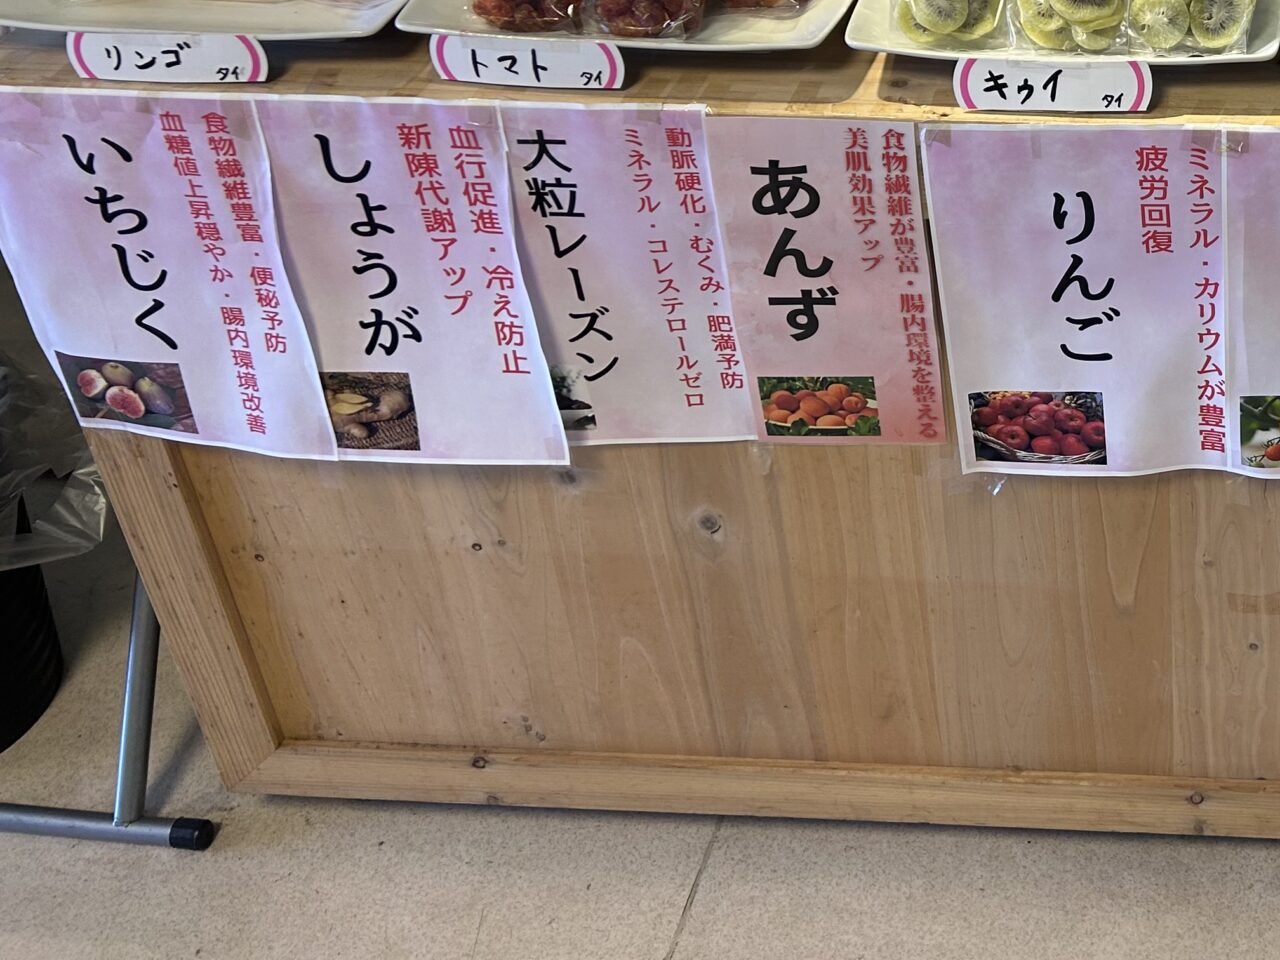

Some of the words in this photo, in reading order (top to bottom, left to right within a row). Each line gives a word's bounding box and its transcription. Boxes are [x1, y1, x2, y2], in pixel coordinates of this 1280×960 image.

[104, 42, 192, 71] リンゴ
[216, 66, 241, 81] タイ
[469, 50, 548, 83] トマト
[580, 71, 603, 86] タイ
[1102, 93, 1123, 108] タイ
[62, 134, 178, 350] いちじく
[159, 112, 267, 435] 血糖値上昇穏やか・腸内環境改善
[201, 112, 287, 354] 食物繊維豊富・便秘予防
[396, 122, 473, 316] 新陳代謝アップ
[448, 126, 531, 375] 血行促進・冷え防止
[517, 129, 618, 382] 大粒レーズン
[623, 128, 704, 408] ミネラル・コレステロールゼロ
[664, 128, 744, 389] 動脈硬化・むくみ・肥満予防
[750, 159, 840, 342] あんず
[844, 127, 884, 272] 美肌効果アップ
[1051, 190, 1121, 362] りんご
[1135, 145, 1174, 254] 疲労回復
[1186, 147, 1226, 454] ミネラル・カリウムが豊富
